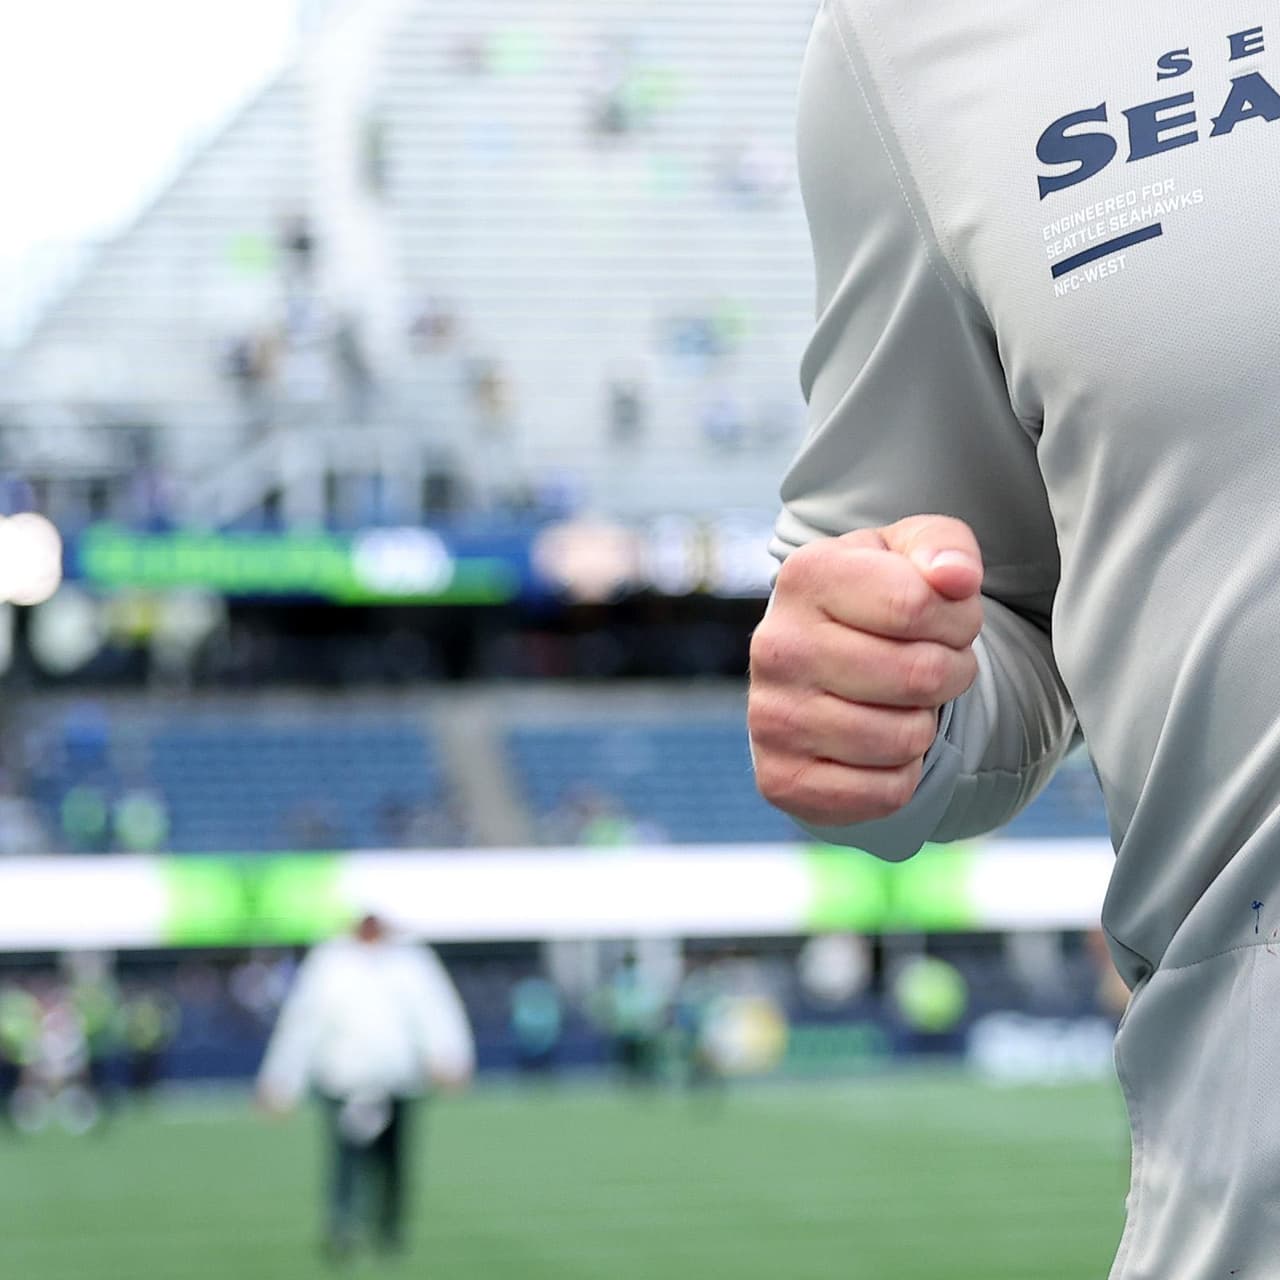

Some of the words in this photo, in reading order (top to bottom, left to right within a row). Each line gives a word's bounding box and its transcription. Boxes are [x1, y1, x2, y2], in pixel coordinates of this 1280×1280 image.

[1043, 190, 1137, 241] ENGINEERED
[1142, 178, 1176, 201] FOR
[1046, 222, 1106, 260] SEATTLE
[1109, 188, 1204, 232] SEAHAWKS
[1054, 255, 1127, 298] NFC-WEST
